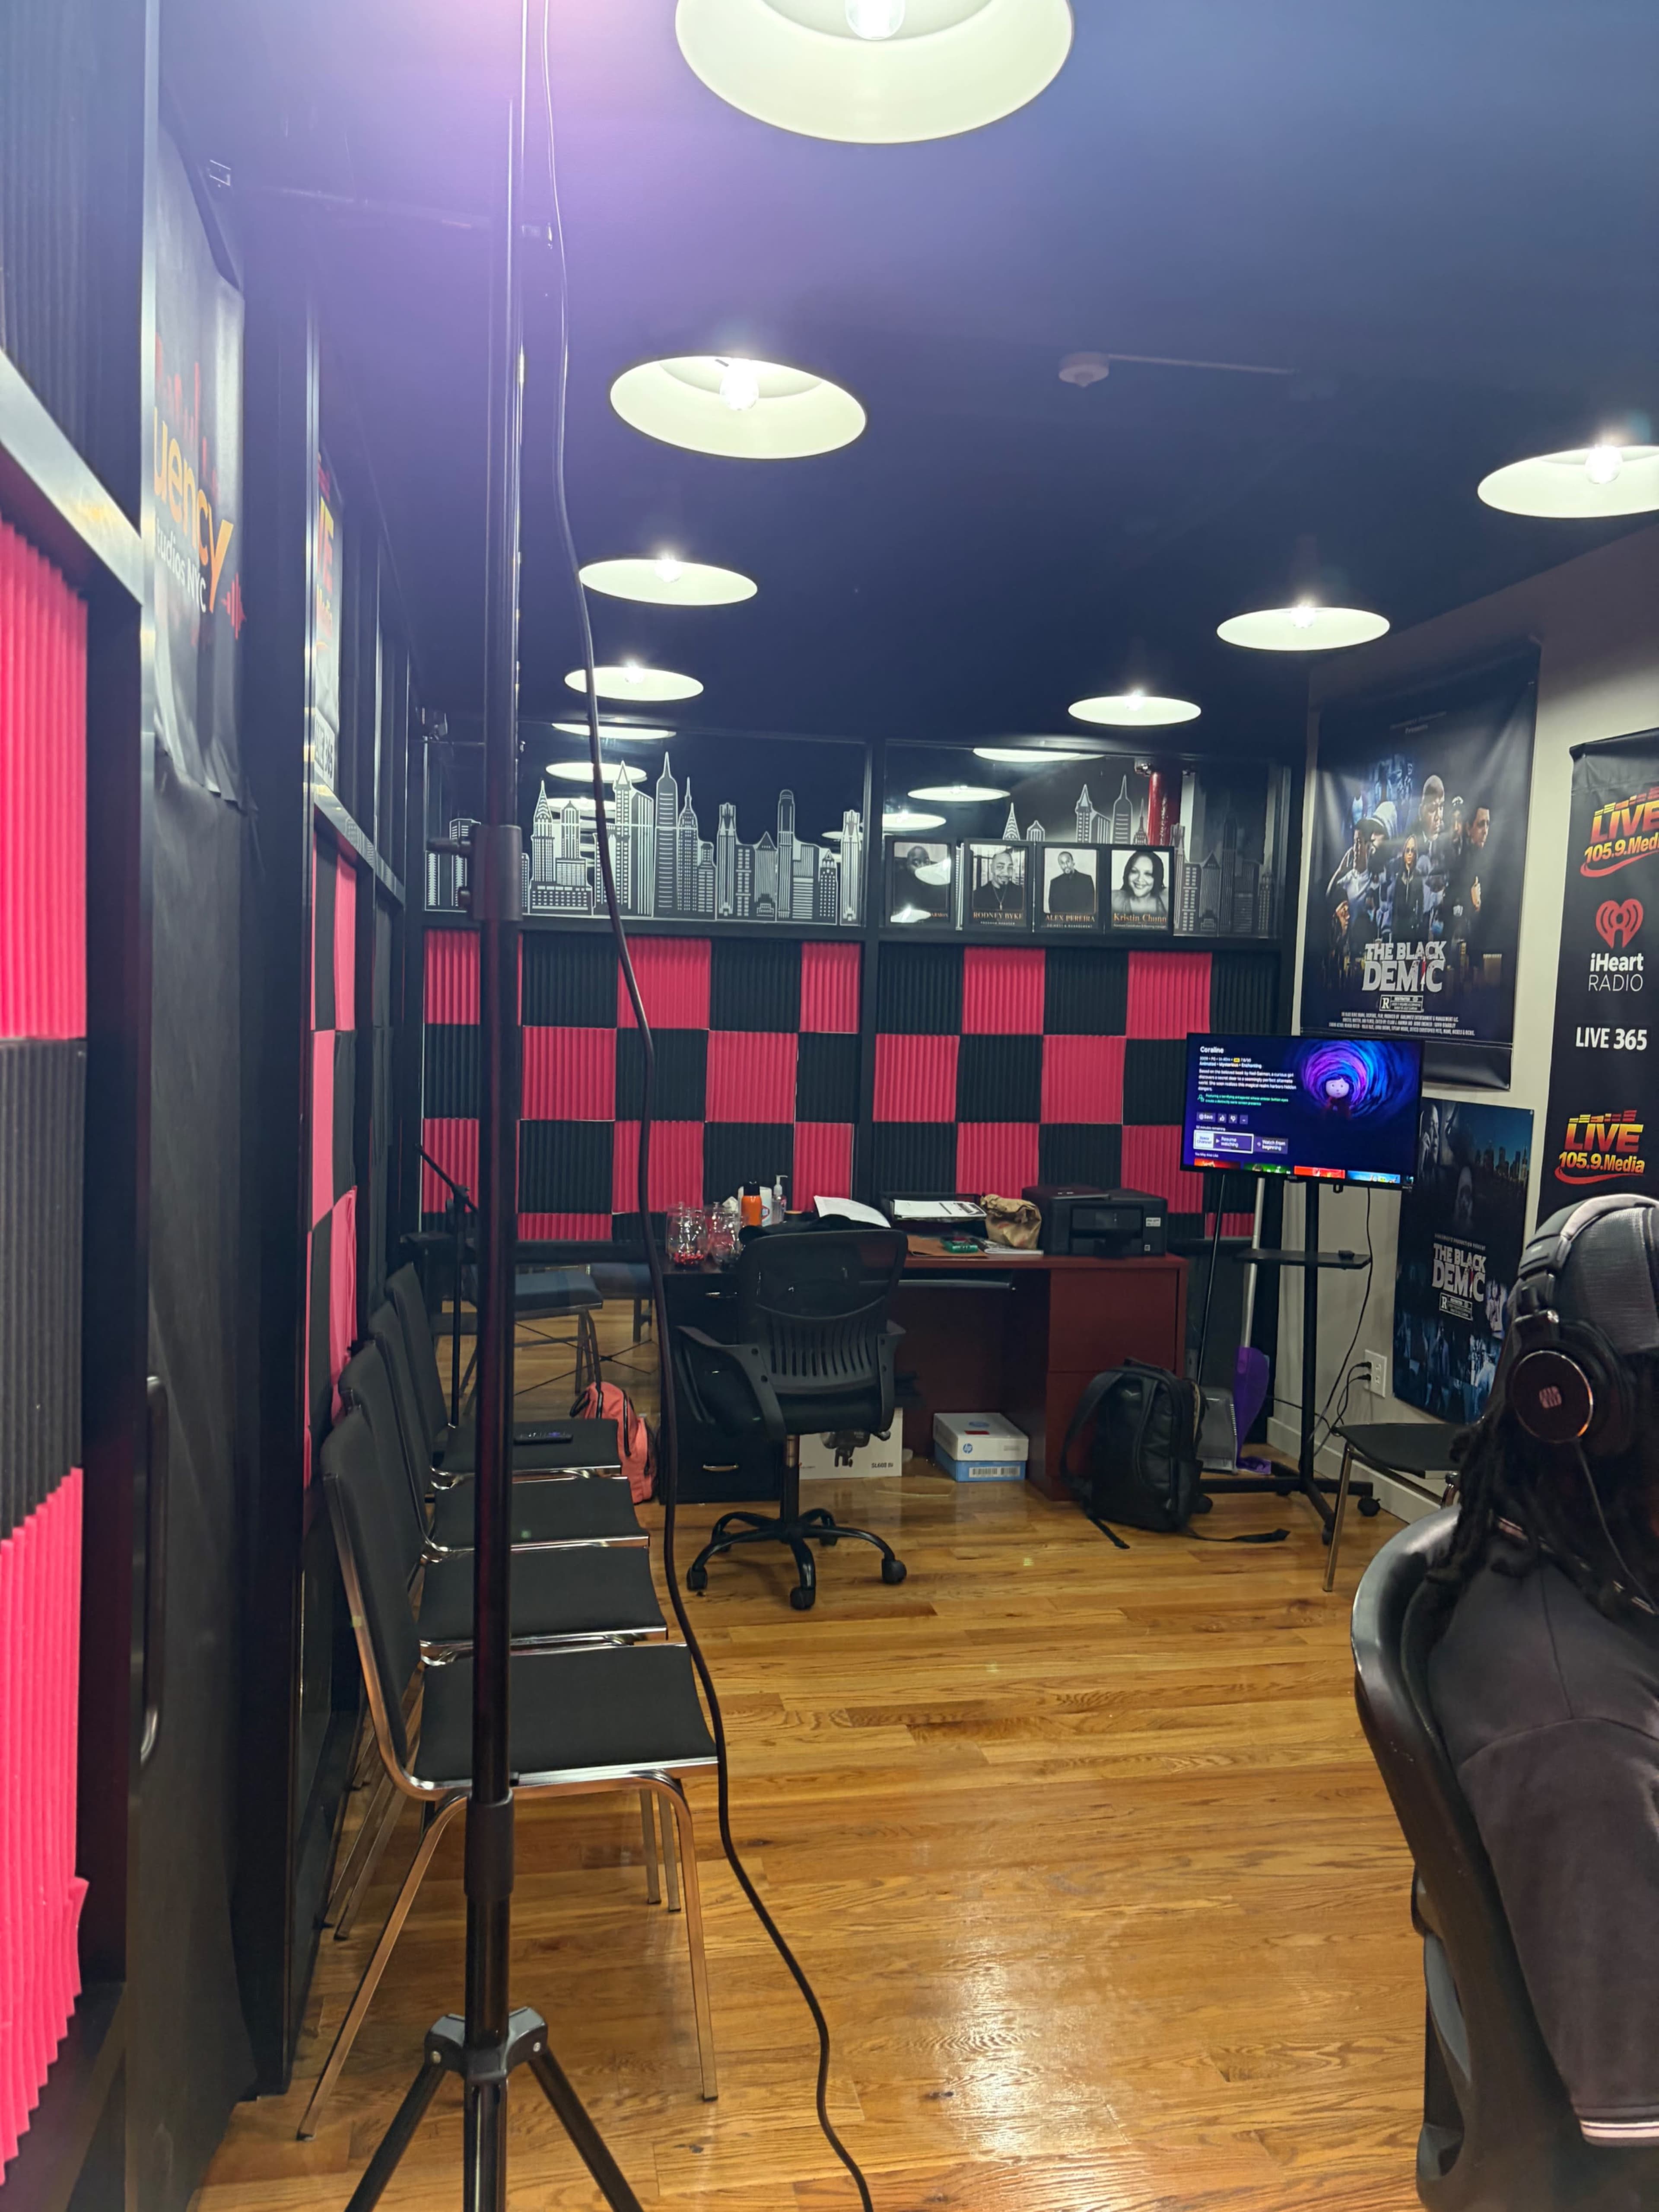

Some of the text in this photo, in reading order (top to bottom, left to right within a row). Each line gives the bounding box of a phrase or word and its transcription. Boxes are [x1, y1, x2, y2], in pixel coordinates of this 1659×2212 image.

[154, 406, 234, 614] uency
[156, 518, 207, 614] tudios NYC
[1590, 799, 1659, 844] LIVE
[1584, 832, 1659, 864] 105.9.Med
[1113, 912, 1166, 923] Kristin Chunn
[1365, 941, 1447, 961] THE BLACK
[1590, 952, 1644, 972] iHeart
[1588, 974, 1643, 992] RADIO
[1382, 997, 1389, 1009] R
[1576, 1027, 1647, 1050] LIVE 365
[1564, 1120, 1644, 1152] LIVE
[1558, 1151, 1645, 1174] 105.9.Media
[1433, 1243, 1486, 1274] THE BLACK
[1441, 1296, 1447, 1309] R
